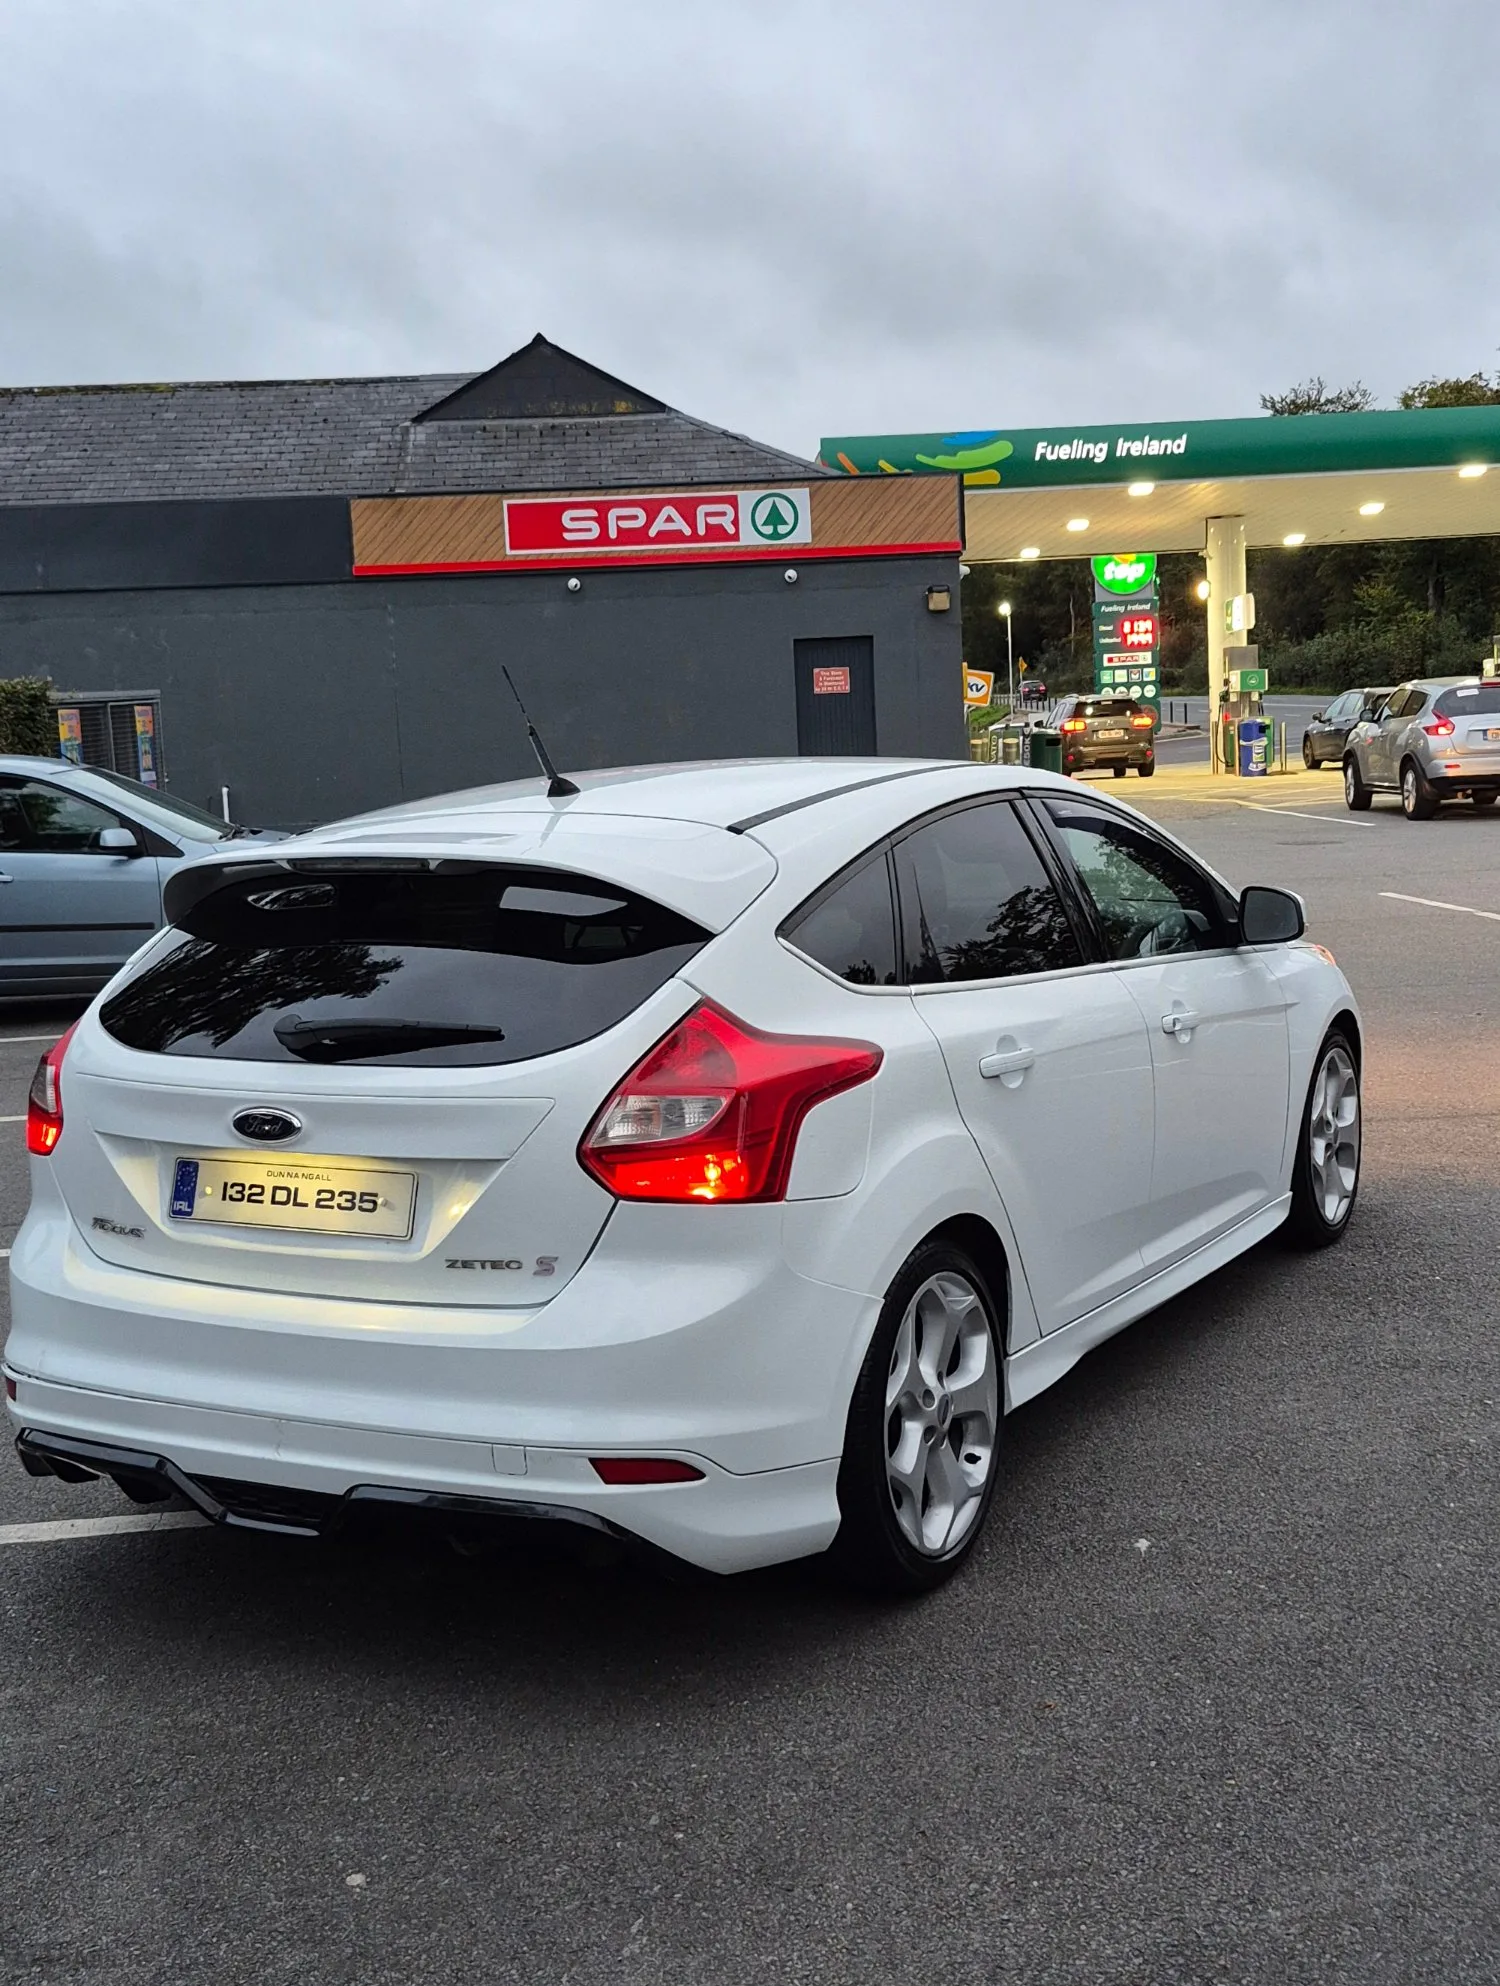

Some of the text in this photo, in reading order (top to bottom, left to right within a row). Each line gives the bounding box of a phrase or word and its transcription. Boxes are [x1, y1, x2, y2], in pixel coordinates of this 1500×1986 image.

[1035, 433, 1187, 463] Fueling Ireland
[561, 503, 735, 541] SPAR
[173, 1200, 192, 1212] IRL
[221, 1181, 379, 1213] 132 DL 235
[444, 1256, 559, 1277] ZETEC S
